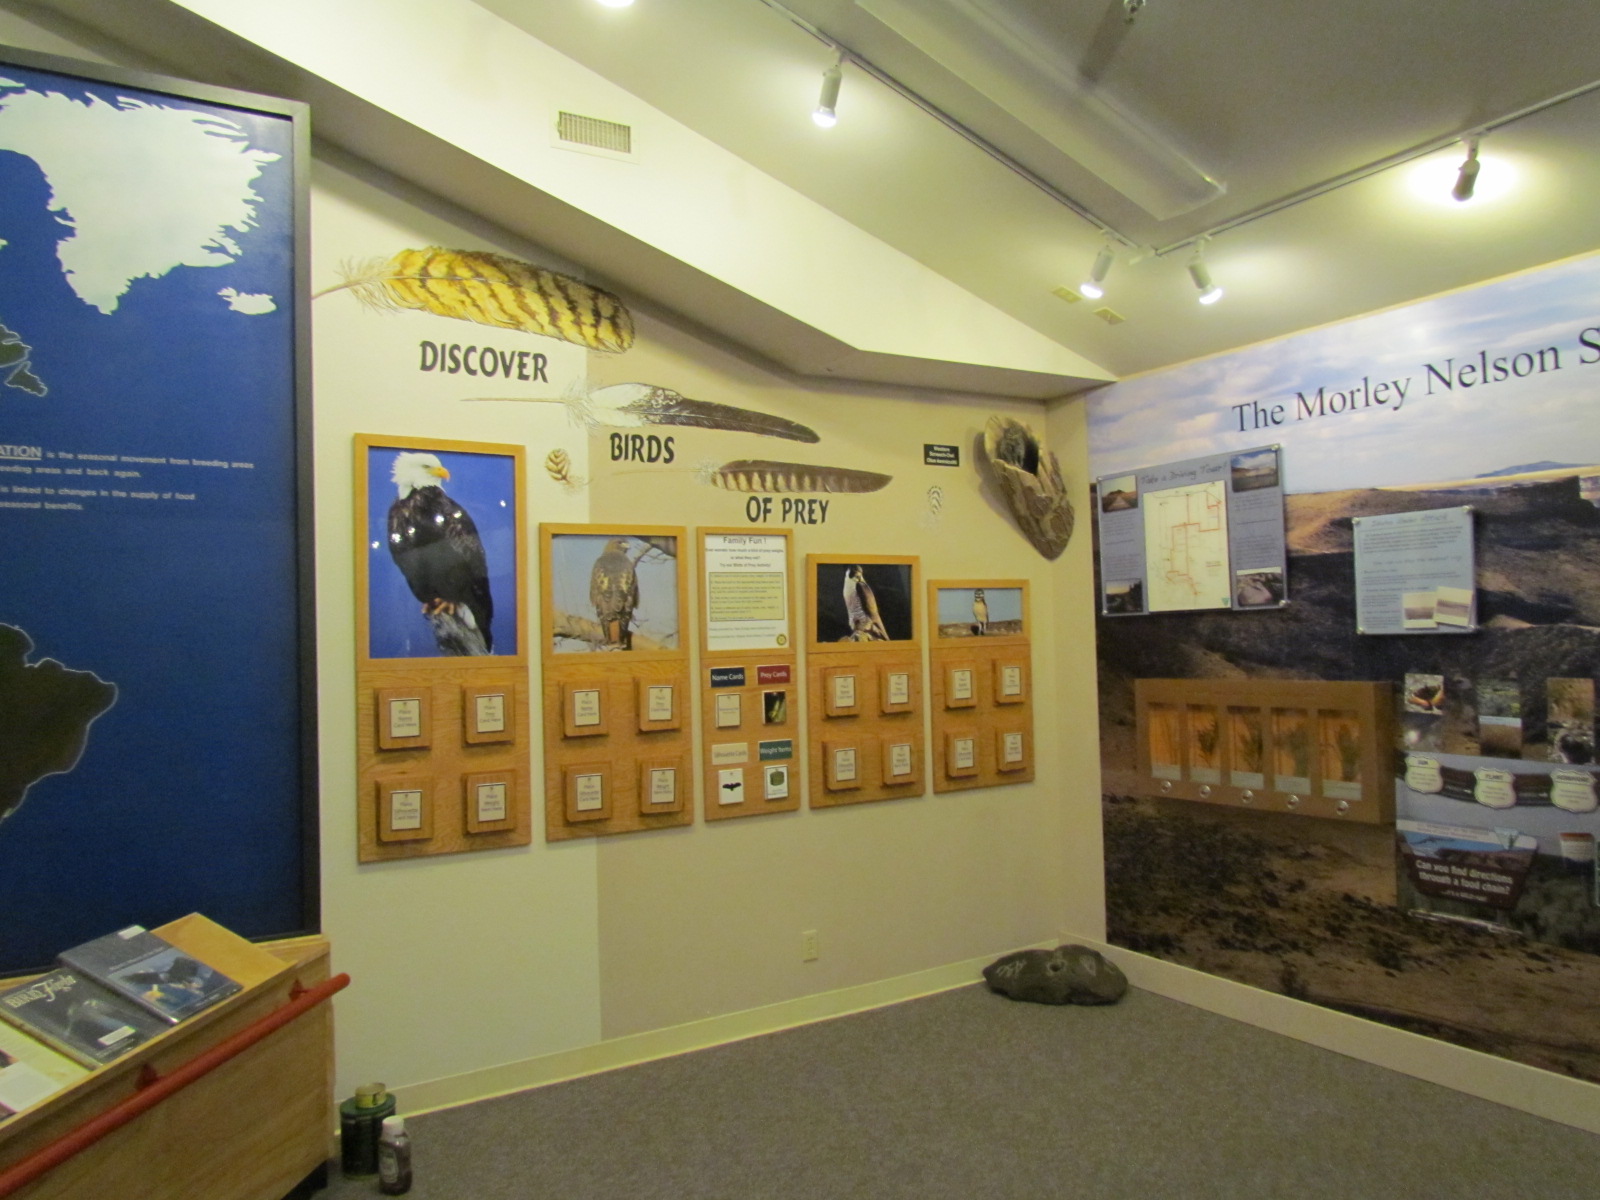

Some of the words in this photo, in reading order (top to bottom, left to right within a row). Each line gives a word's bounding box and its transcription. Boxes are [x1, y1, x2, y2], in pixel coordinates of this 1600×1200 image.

[420, 340, 549, 383] DISCOVER
[1232, 400, 1285, 432] The
[1294, 376, 1412, 420] Morley
[1422, 346, 1562, 395] Nelson
[610, 432, 676, 465] BIRDS
[192, 459, 229, 468] breeding
[175, 492, 196, 500] food
[745, 496, 773, 523] OF
[781, 498, 829, 525] PREY
[723, 537, 746, 545] Family
[1415, 860, 1432, 870] Can
[1434, 864, 1449, 874] you
[1450, 865, 1467, 876] find
[1469, 868, 1514, 884] directions
[1418, 871, 1452, 884] through
[1461, 878, 1480, 890] food
[1482, 883, 1510, 894] chain?
